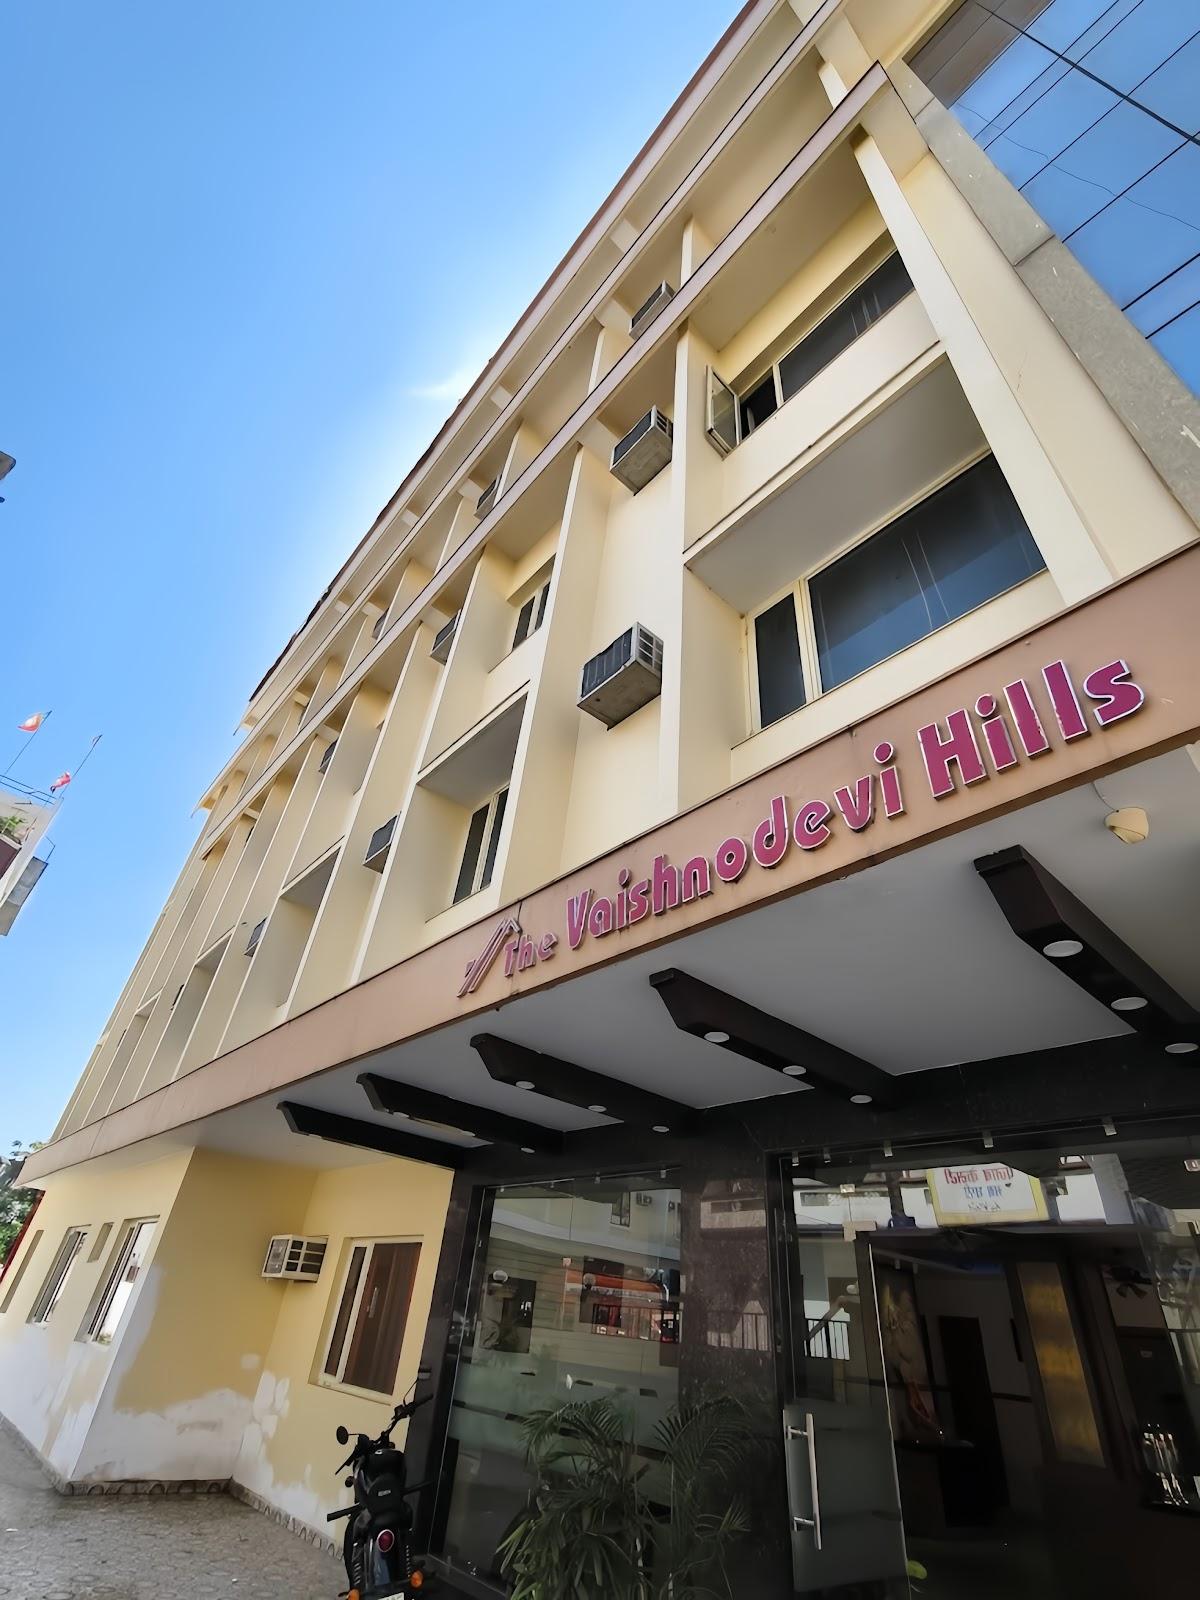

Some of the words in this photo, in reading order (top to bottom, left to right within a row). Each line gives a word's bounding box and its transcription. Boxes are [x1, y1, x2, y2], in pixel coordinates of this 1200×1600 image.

[503, 933, 558, 977] The
[566, 741, 905, 950] Vaishnodevi
[917, 659, 1146, 799] Hills
